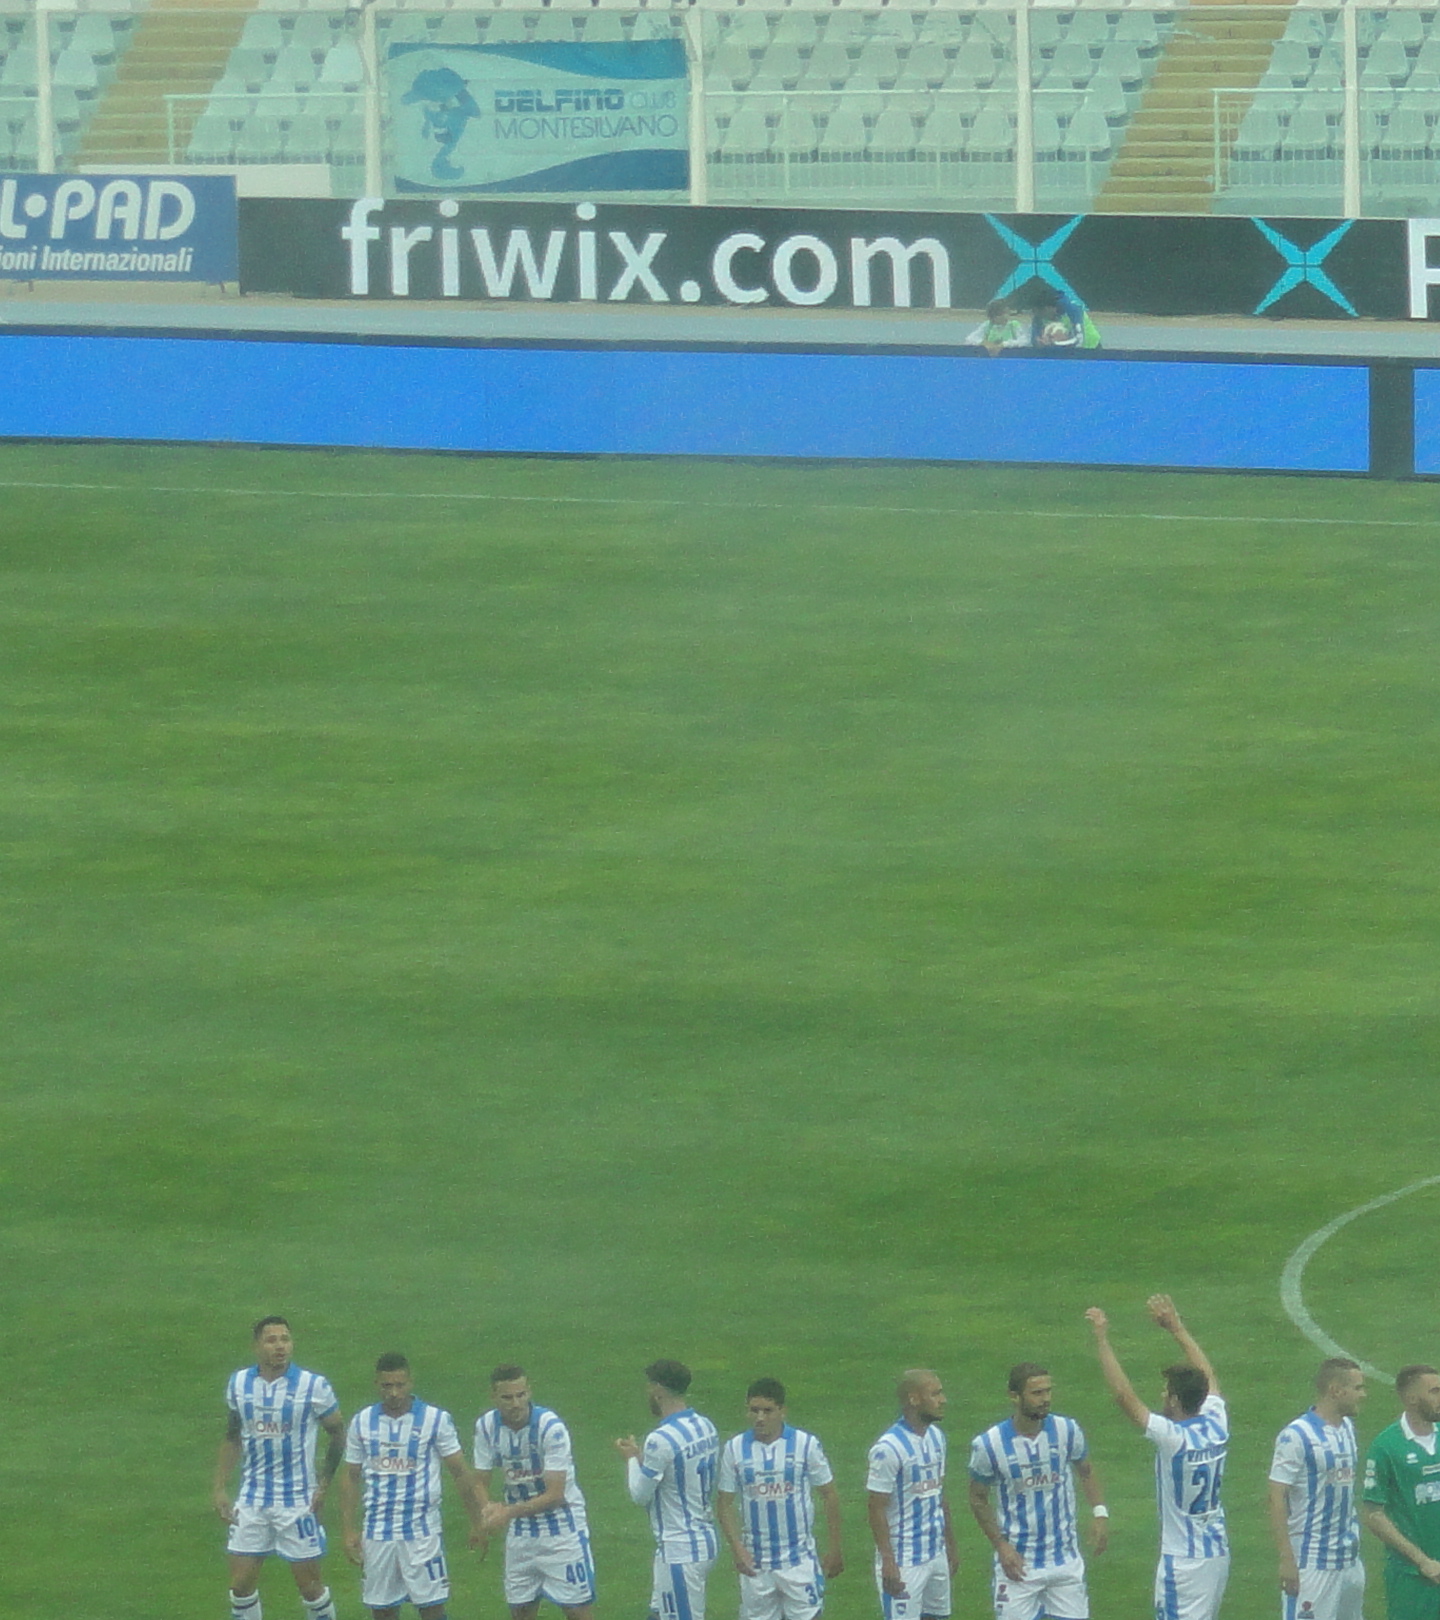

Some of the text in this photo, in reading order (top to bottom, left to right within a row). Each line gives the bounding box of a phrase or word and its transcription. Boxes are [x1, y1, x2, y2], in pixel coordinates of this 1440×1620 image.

[493, 114, 679, 139] MONTESILVANO
[41, 244, 194, 273] Internazionali
[341, 199, 951, 309] friwix.com
[294, 1514, 314, 1539] 10
[424, 1555, 445, 1581] 17
[565, 1562, 586, 1586] 40
